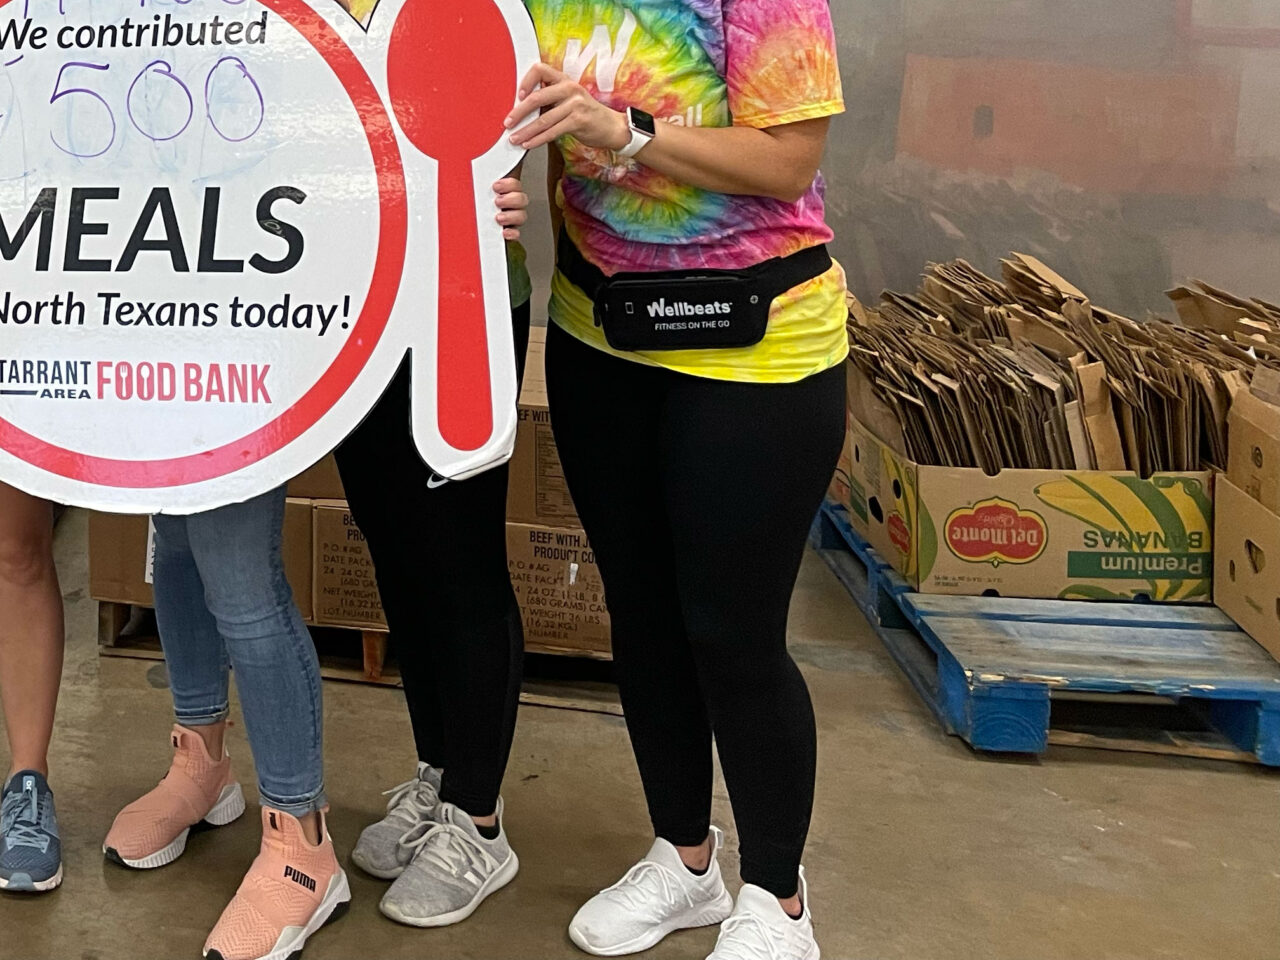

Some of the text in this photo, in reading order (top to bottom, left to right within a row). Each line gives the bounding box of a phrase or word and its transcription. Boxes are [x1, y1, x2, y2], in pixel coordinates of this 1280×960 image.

[56, 10, 268, 49] contributed
[97, 293, 218, 328] Texans
[229, 294, 351, 336] today!
[647, 298, 731, 317] Wellbeats
[655, 322, 687, 330] FITNESS
[688, 321, 700, 329] ON
[701, 320, 717, 328] THE
[97, 361, 176, 401] FOOD
[184, 363, 273, 403] BANK
[40, 389, 91, 399] AREA
[532, 410, 549, 422] WIT
[343, 514, 356, 526] BE
[347, 529, 366, 541] PRO
[529, 531, 554, 543] BEEF
[556, 533, 580, 547] WITH
[952, 526, 1038, 546] Del Monte
[1083, 531, 1203, 549] BANANAS
[348, 557, 371, 566] PACK
[534, 546, 595, 564] PRODUCT CO
[1101, 556, 1203, 575] Premium
[530, 608, 568, 620] WEIGHT
[284, 865, 316, 893] PUMA
